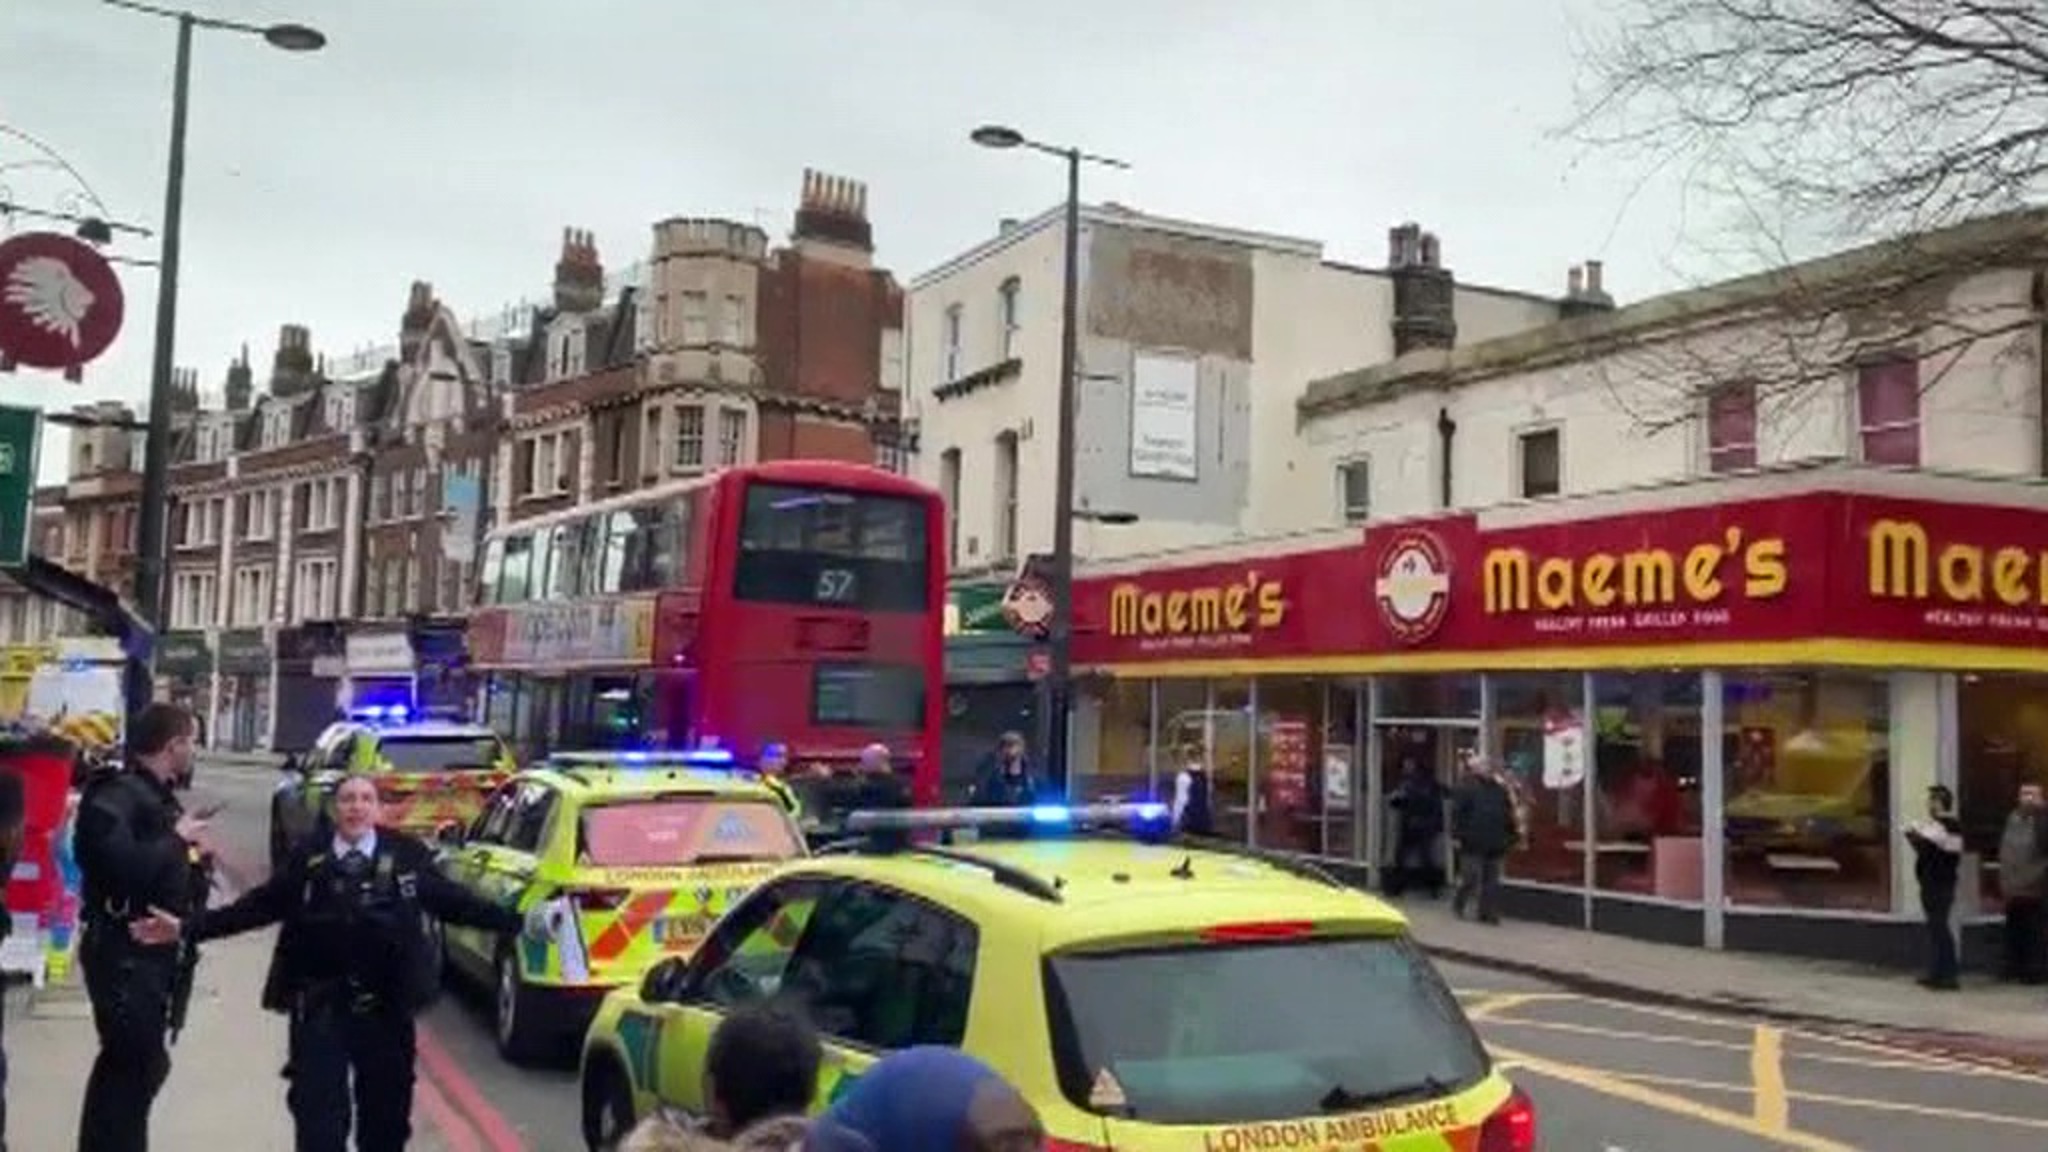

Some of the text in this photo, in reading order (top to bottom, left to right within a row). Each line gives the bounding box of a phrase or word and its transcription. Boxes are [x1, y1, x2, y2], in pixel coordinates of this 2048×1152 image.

[818, 569, 853, 600] 57
[1484, 526, 1786, 613] Maeme's
[1870, 518, 2048, 606] Mae
[1111, 570, 1284, 636] Maeme's
[1203, 1102, 1457, 1152] LONDON AMBULANCE
